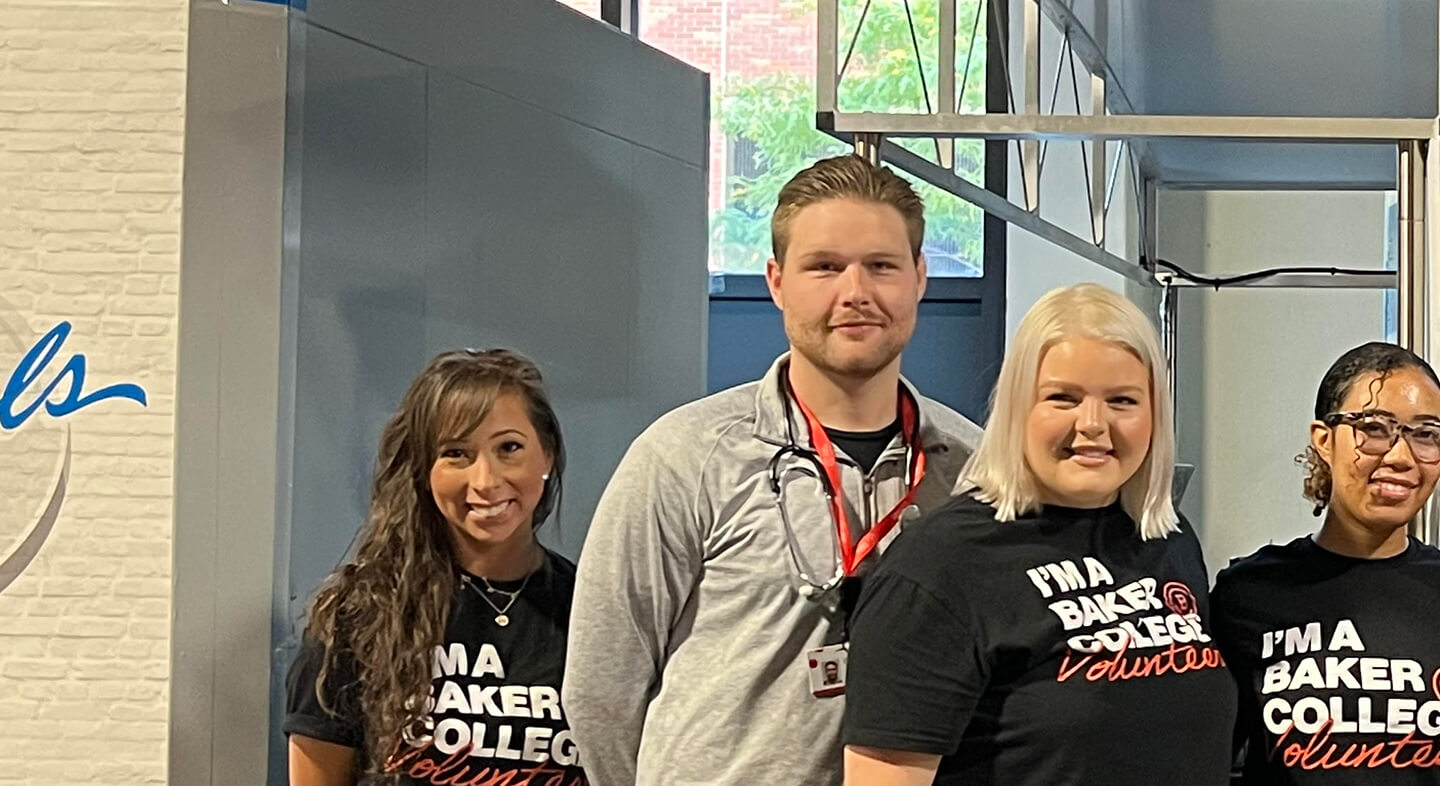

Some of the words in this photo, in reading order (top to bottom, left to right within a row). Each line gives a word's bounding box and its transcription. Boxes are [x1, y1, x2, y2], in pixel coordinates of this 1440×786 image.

[1026, 560, 1087, 598] I'M
[1083, 557, 1114, 588] A
[1048, 577, 1164, 630] BAKER
[1262, 622, 1322, 659] I'M
[1328, 619, 1365, 651] A
[471, 643, 505, 679] A
[1262, 657, 1426, 694] BAKER
[402, 714, 579, 766] COLLEG
